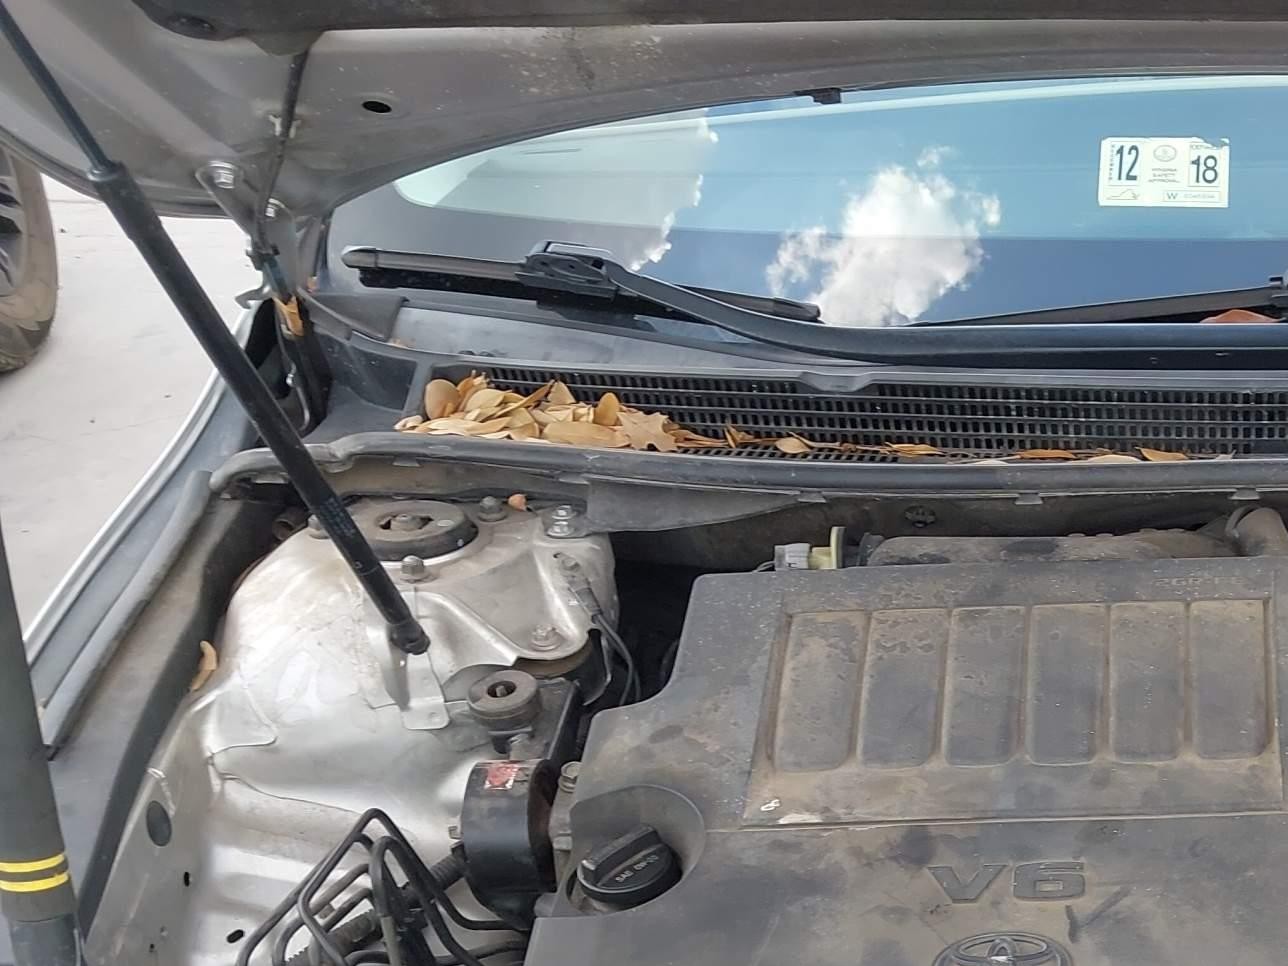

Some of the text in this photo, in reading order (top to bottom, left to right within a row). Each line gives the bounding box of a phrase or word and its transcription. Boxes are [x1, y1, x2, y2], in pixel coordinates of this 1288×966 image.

[1116, 145, 1139, 181] 12
[1191, 155, 1218, 184] 18
[1167, 192, 1179, 200] W
[927, 861, 1086, 904] V6
